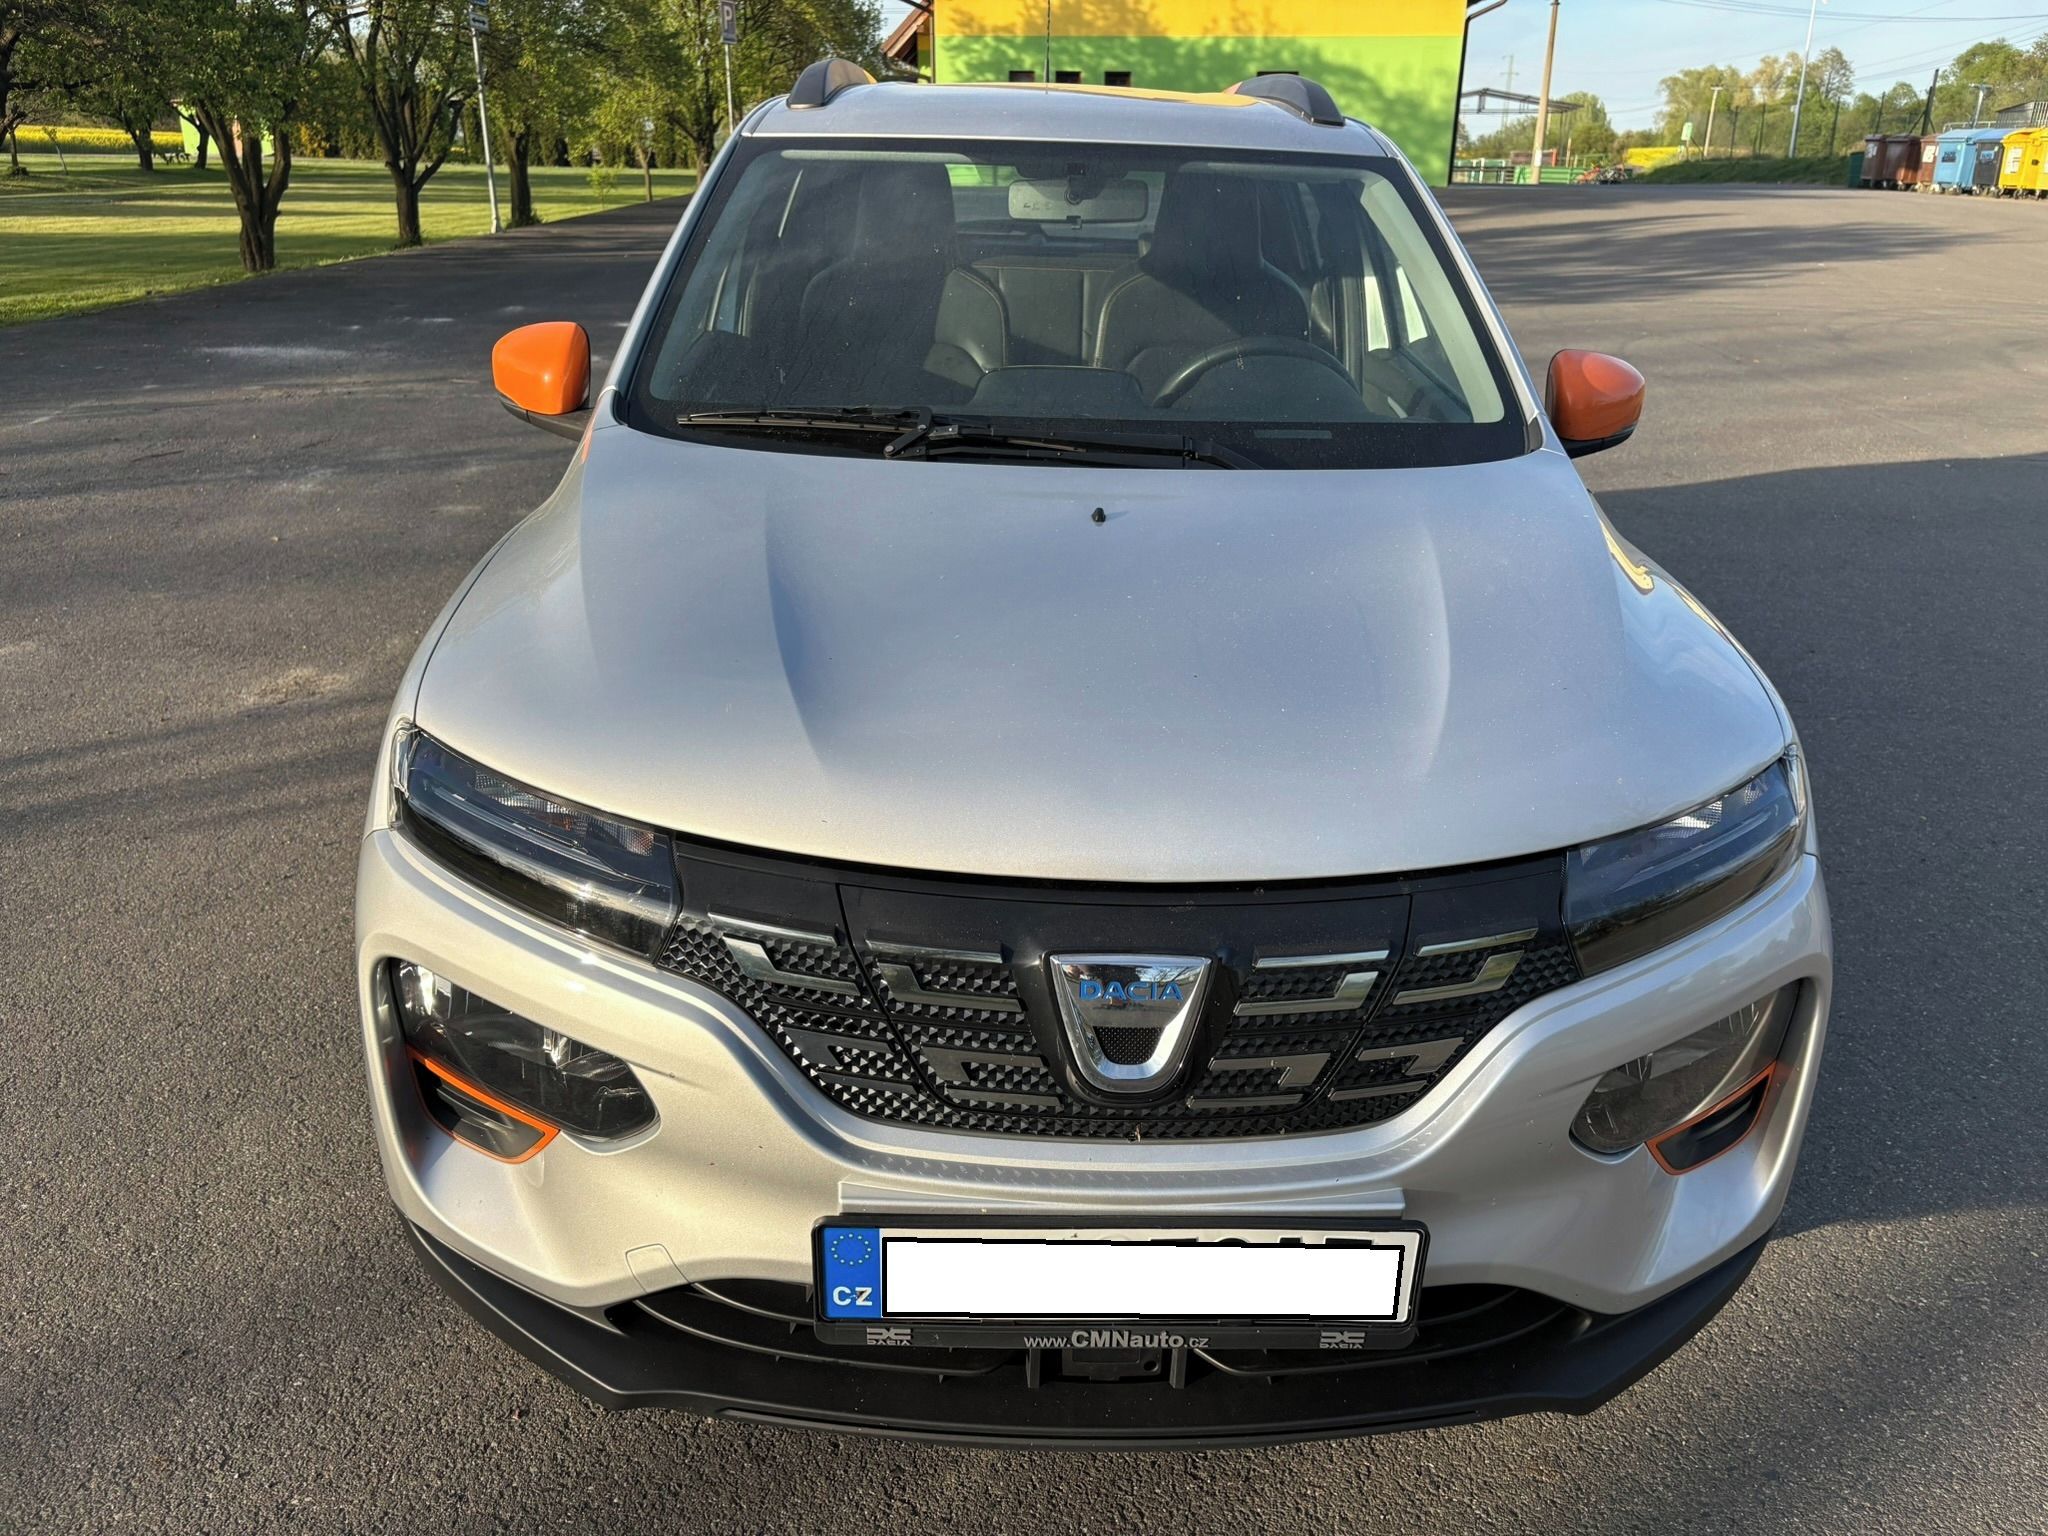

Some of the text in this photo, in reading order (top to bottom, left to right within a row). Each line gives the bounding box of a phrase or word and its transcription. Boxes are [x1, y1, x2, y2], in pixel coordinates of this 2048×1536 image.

[723, 5, 733, 30] P
[1079, 979, 1184, 1001] DACIA
[833, 1286, 873, 1306] CZ
[1023, 1330, 1208, 1349] www.CMNauto.cz
